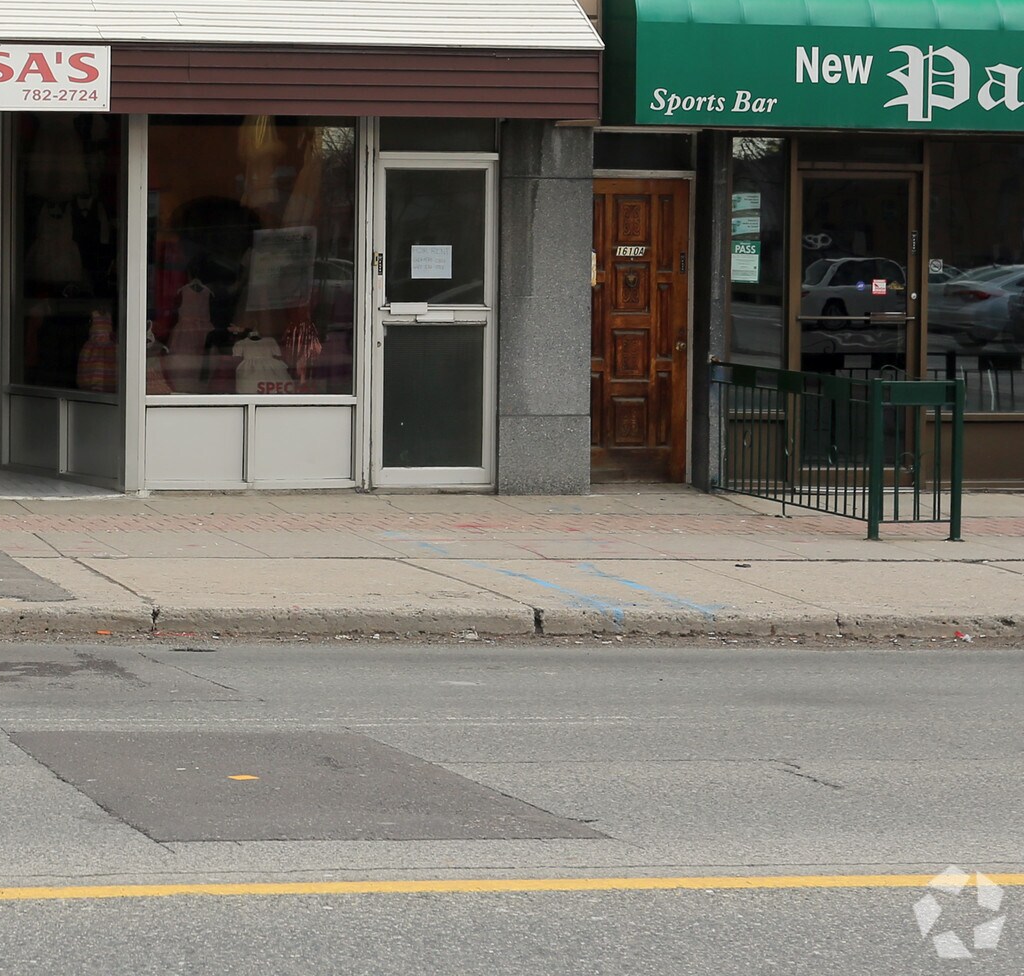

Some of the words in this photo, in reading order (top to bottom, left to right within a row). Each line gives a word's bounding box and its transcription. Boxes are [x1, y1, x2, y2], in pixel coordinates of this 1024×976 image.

[795, 46, 874, 84] New
[22, 89, 98, 101] 782-2724
[650, 87, 726, 116] Sports
[731, 90, 778, 113] Bar
[618, 246, 644, 256] 1610A
[735, 244, 756, 254] PASS
